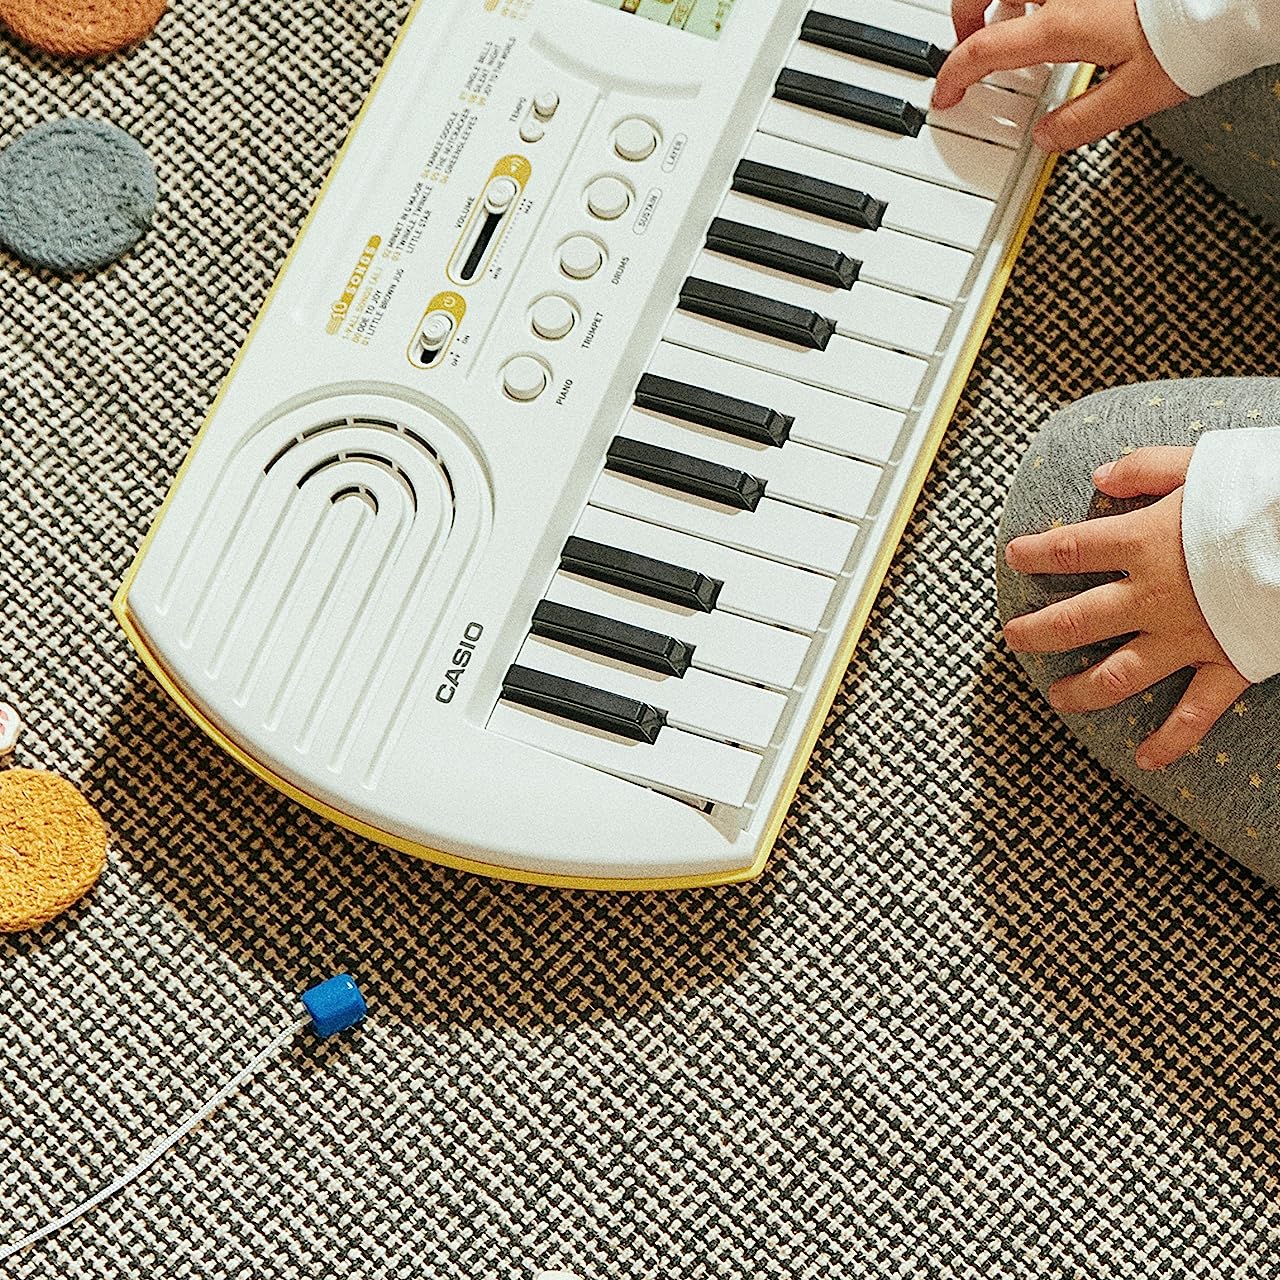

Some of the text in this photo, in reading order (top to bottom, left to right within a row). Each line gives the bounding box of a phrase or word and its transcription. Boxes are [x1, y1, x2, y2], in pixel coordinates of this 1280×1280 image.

[509, 95, 527, 123] TEMPO
[666, 140, 683, 165] LAYER
[455, 196, 475, 228] VOLUME
[637, 194, 658, 227] SUSTAIN
[406, 228, 423, 253] LITTLE
[329, 301, 350, 320] 10
[346, 244, 378, 295] SONGS
[610, 255, 630, 285] DRUMS
[366, 304, 375, 314] TO
[372, 288, 383, 303] JOY
[367, 311, 383, 335] LITTLE
[380, 283, 397, 309] BROWN
[580, 311, 605, 349] TRUMPET
[555, 378, 574, 405] PIANO
[434, 620, 485, 704] CASIO
